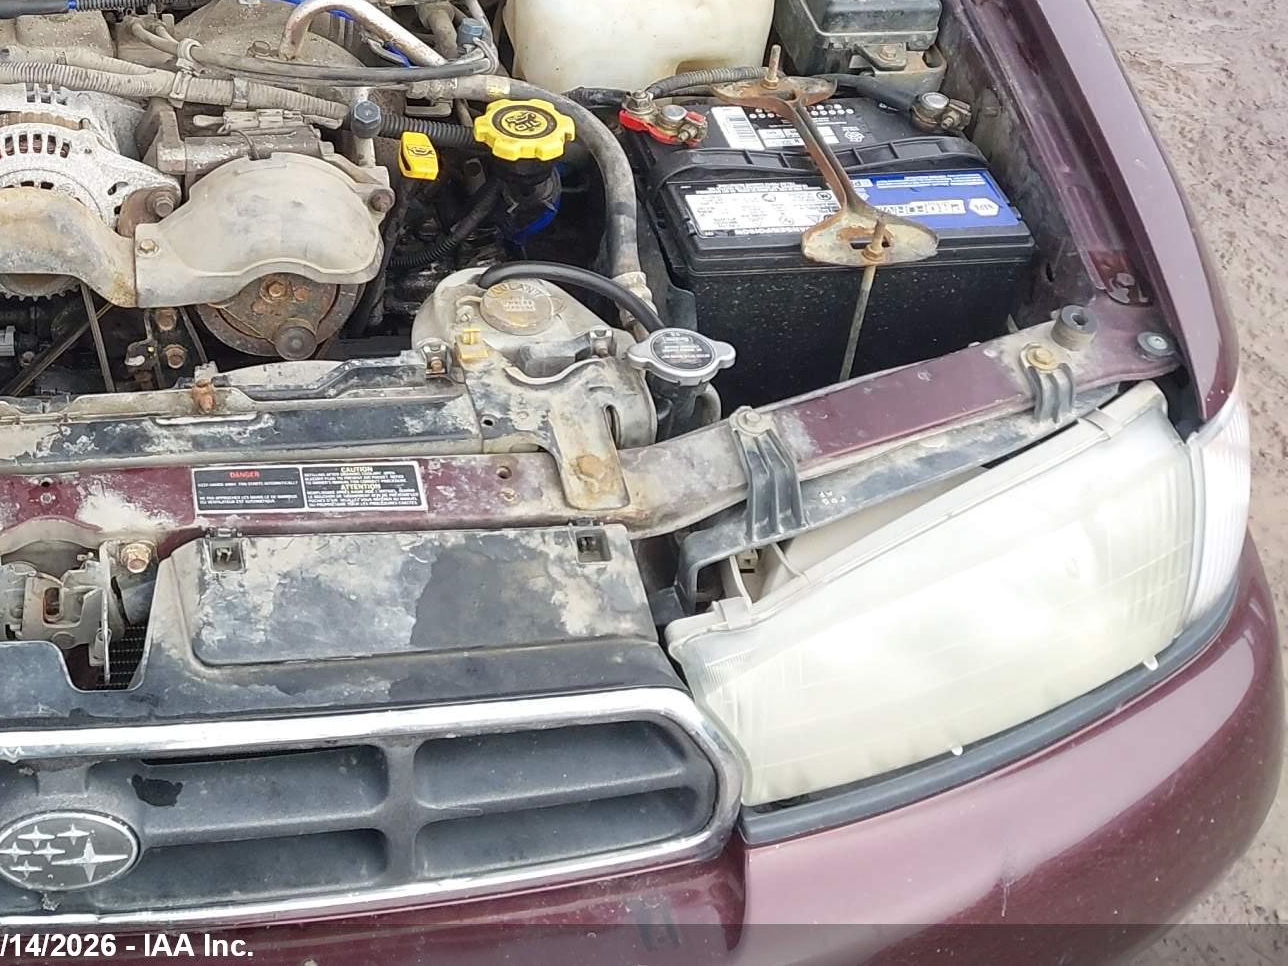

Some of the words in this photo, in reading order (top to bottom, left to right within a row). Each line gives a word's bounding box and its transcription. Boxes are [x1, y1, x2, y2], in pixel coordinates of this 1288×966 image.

[515, 120, 541, 131] OIL
[230, 471, 260, 479] DANGER
[340, 483, 381, 491] ATTENTION
